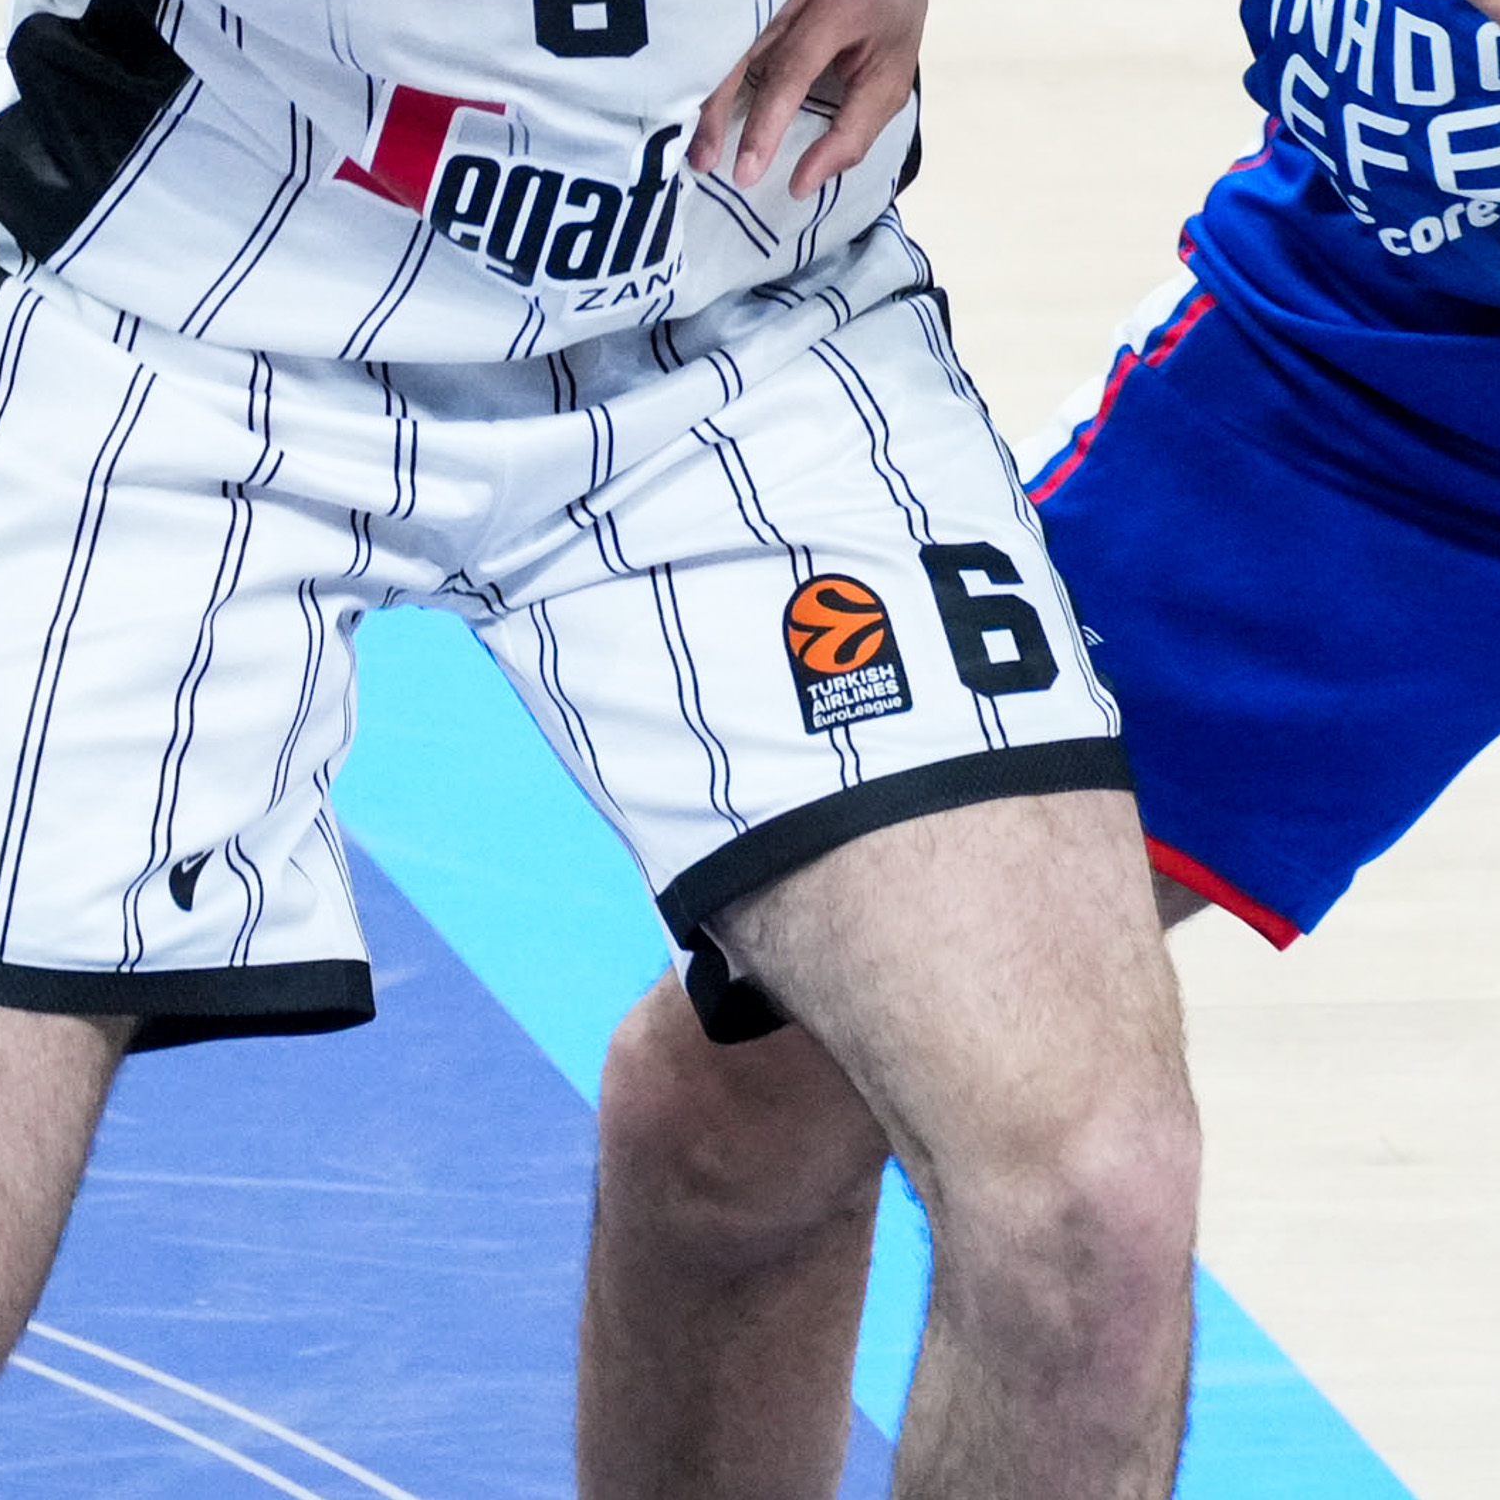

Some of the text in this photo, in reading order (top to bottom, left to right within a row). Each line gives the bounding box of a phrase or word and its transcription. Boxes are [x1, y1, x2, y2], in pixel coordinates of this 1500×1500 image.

[919, 541, 1059, 697] 6
[806, 663, 896, 699] TURKISH
[812, 679, 900, 714] AIRLINES
[812, 696, 903, 729] EuroLeague
